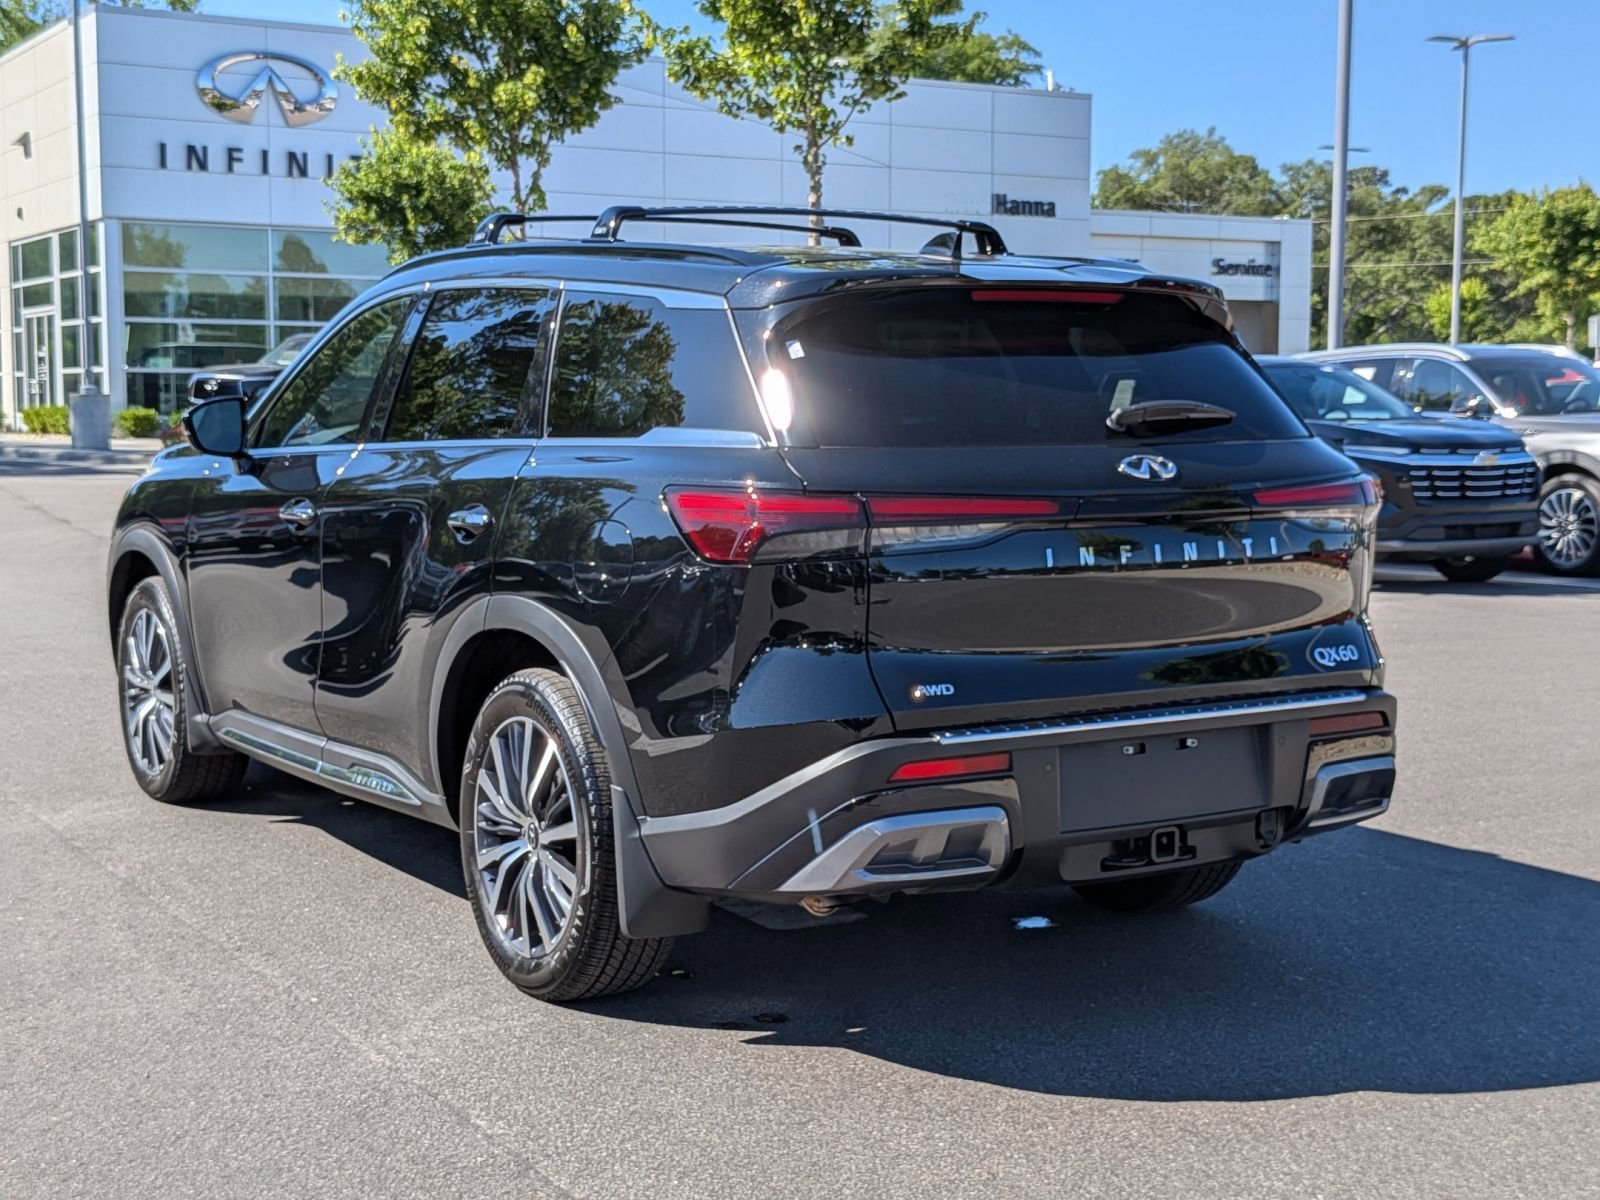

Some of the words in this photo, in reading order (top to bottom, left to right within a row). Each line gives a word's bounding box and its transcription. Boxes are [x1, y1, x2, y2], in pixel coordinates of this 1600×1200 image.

[991, 193, 1056, 217] Hanna
[1211, 258, 1272, 277] Service
[1046, 536, 1278, 568] INFINITI
[1314, 644, 1359, 667] QX60
[916, 683, 955, 697] AWD
